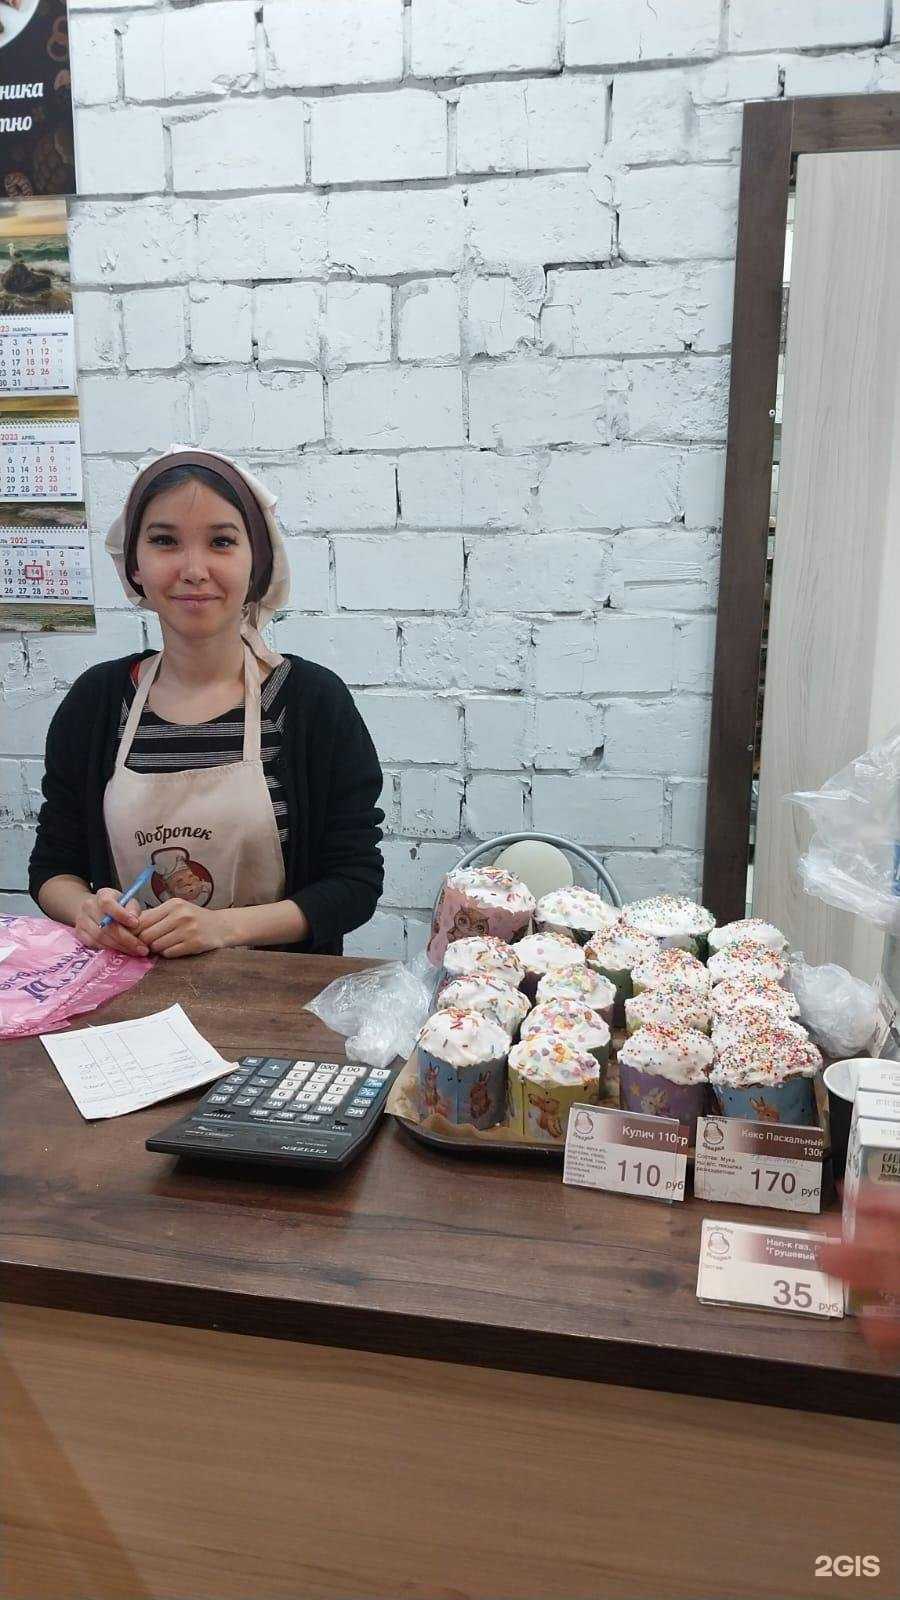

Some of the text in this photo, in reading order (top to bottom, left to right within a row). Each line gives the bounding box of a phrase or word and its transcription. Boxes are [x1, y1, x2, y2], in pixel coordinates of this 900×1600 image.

[1, 433, 18, 441] 2023
[135, 824, 214, 846] Добропек
[622, 1125, 688, 1147] Кулич 110гр
[741, 1128, 824, 1147] Кекс Пасхальный
[280, 1145, 328, 1155] CITIZEN
[618, 1159, 661, 1187] 110
[665, 1180, 684, 1191] руб
[750, 1168, 820, 1197] 170 руб
[773, 1279, 842, 1314] 35 руб.
